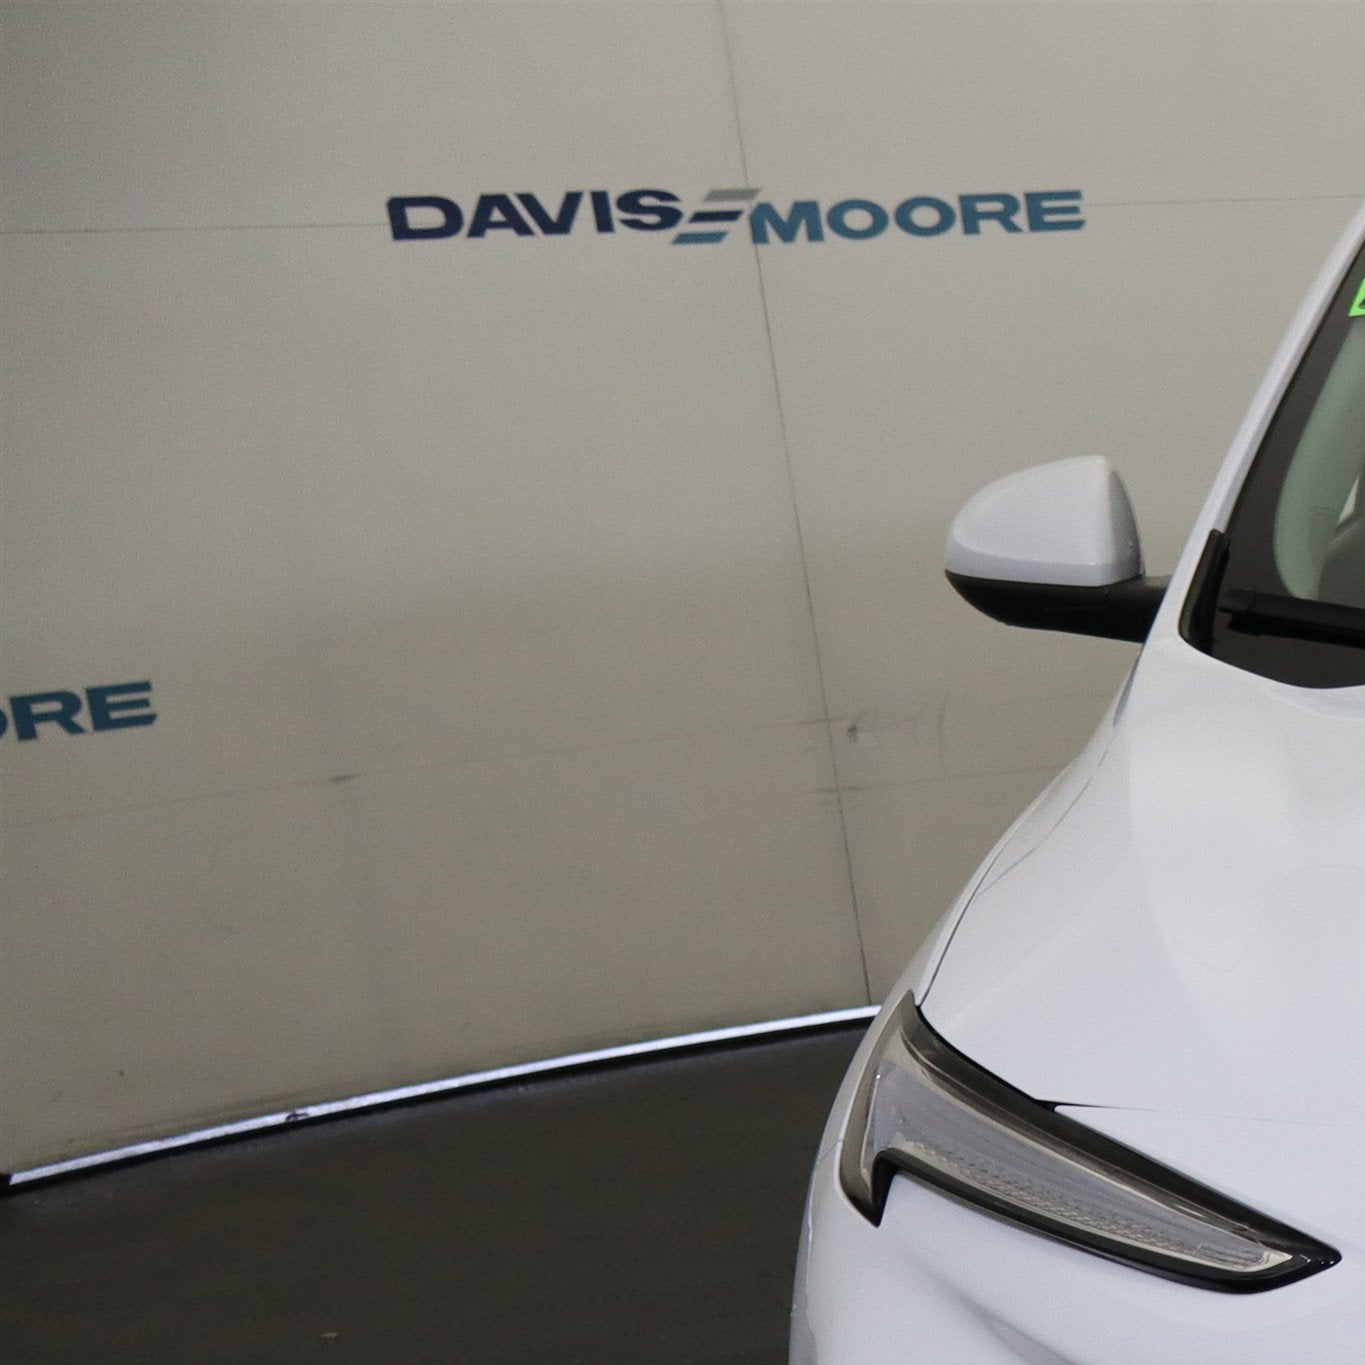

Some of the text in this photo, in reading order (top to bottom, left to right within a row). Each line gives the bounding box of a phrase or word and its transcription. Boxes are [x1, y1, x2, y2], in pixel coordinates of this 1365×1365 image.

[386, 189, 1087, 245] DAVIS MOORE
[0, 680, 158, 741] RE
